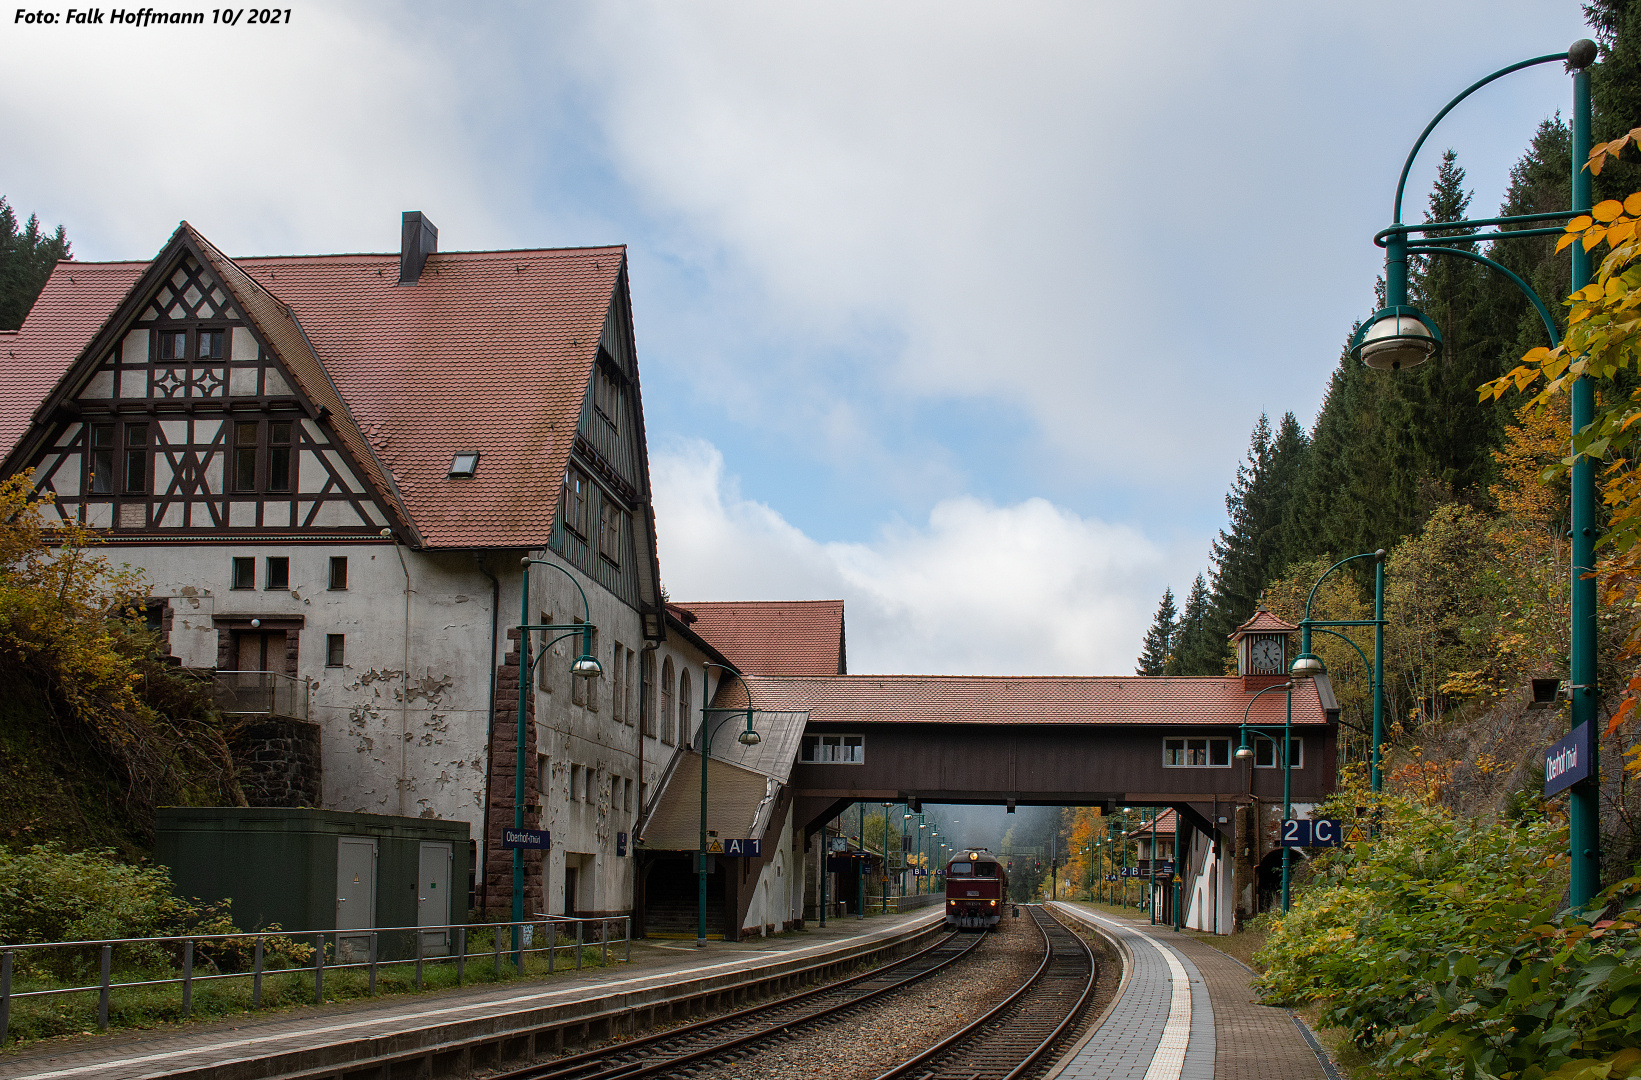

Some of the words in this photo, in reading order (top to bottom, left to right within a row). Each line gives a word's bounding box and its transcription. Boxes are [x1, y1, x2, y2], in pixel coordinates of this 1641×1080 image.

[1546, 746, 1566, 783] Oberhof
[506, 830, 529, 843] Oberhof
[1284, 819, 1299, 841] 2
[1315, 819, 1332, 842] C
[729, 839, 741, 853] A
[752, 839, 759, 854] 1
[1121, 867, 1127, 876] 2
[1132, 867, 1139, 876] B
